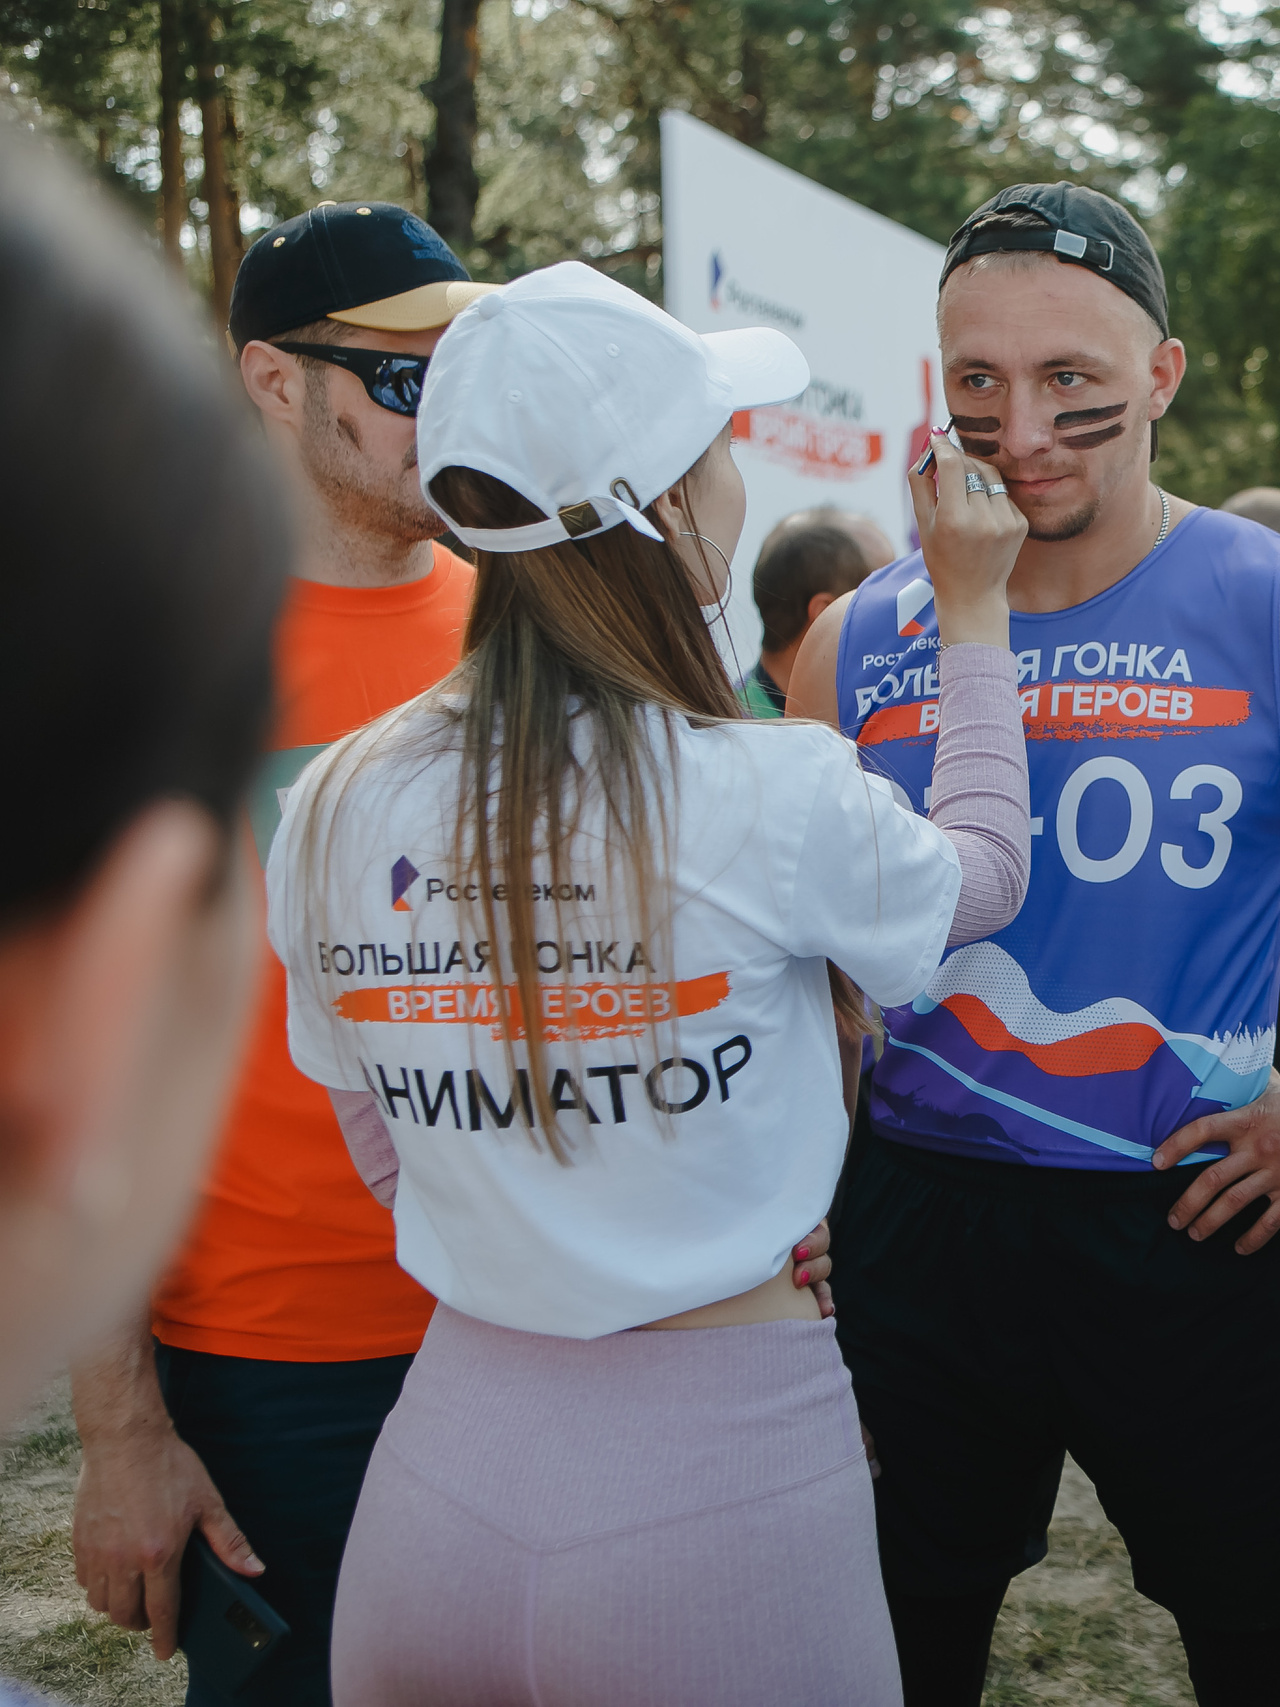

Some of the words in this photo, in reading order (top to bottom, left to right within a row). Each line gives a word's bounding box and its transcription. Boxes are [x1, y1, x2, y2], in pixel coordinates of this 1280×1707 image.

[855, 649, 1041, 720] БОЛЬЯ
[1050, 641, 1193, 683] ГОНКА
[1050, 685, 1194, 721] ГЕРОЕВ
[512, 940, 656, 975] ОНКА
[387, 987, 512, 1021] ВРЕМЯ
[540, 986, 672, 1019] ЕРОЕВ
